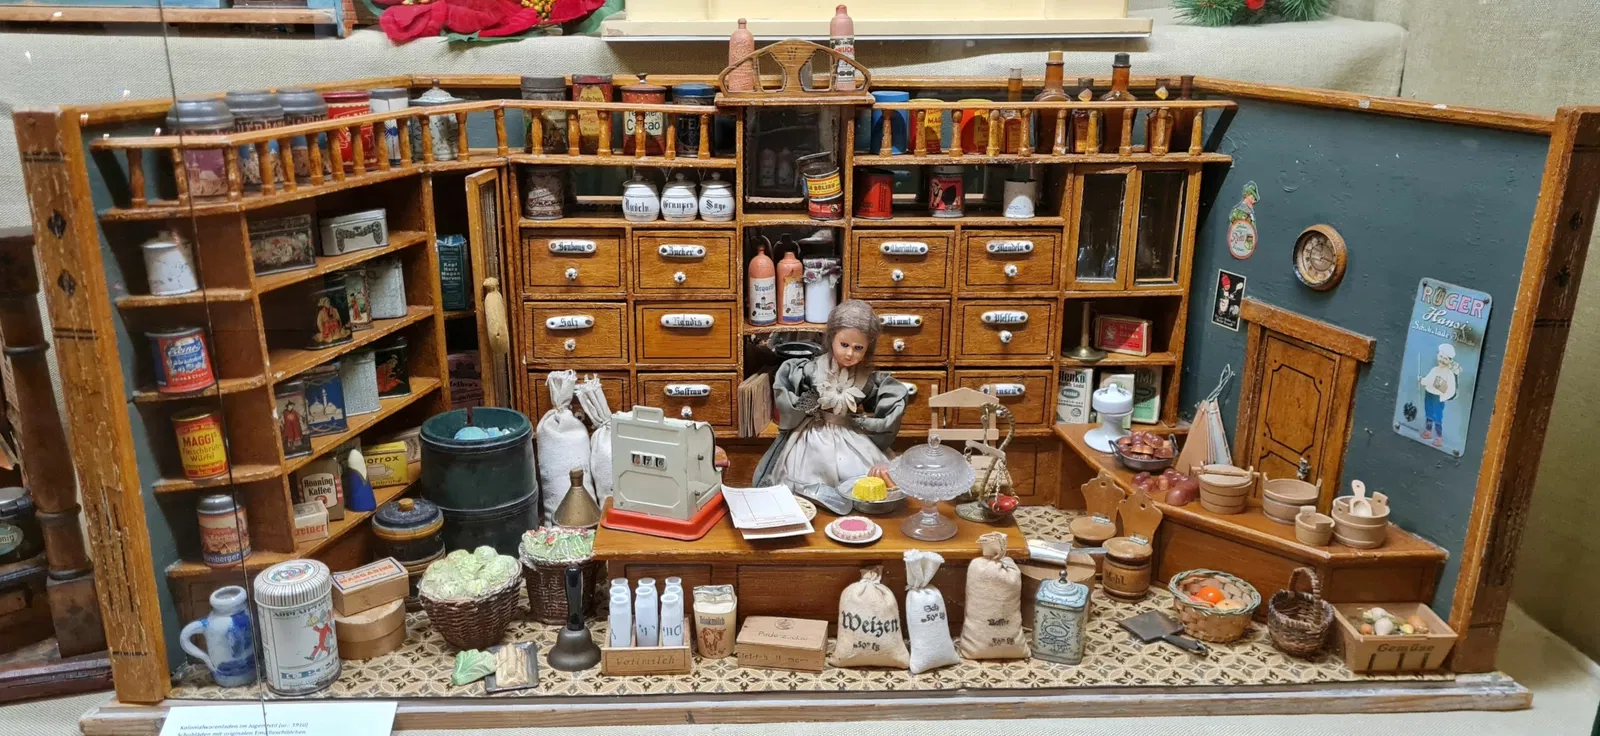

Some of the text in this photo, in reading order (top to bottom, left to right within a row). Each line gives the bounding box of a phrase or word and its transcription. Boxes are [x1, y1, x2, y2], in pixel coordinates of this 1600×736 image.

[626, 118, 660, 131] Ccao
[995, 242, 1024, 252] Mandeln
[994, 313, 1019, 323] Pfeffer
[294, 524, 325, 536] reiner
[0, 535, 15, 543] onig
[339, 564, 395, 584] MARGARINE
[1105, 570, 1127, 586] Mehl
[699, 615, 725, 625] Trinkmilch
[841, 610, 899, 638] Weizen
[1376, 643, 1435, 653] Gemüse
[248, 722, 278, 730] Jugenstil
